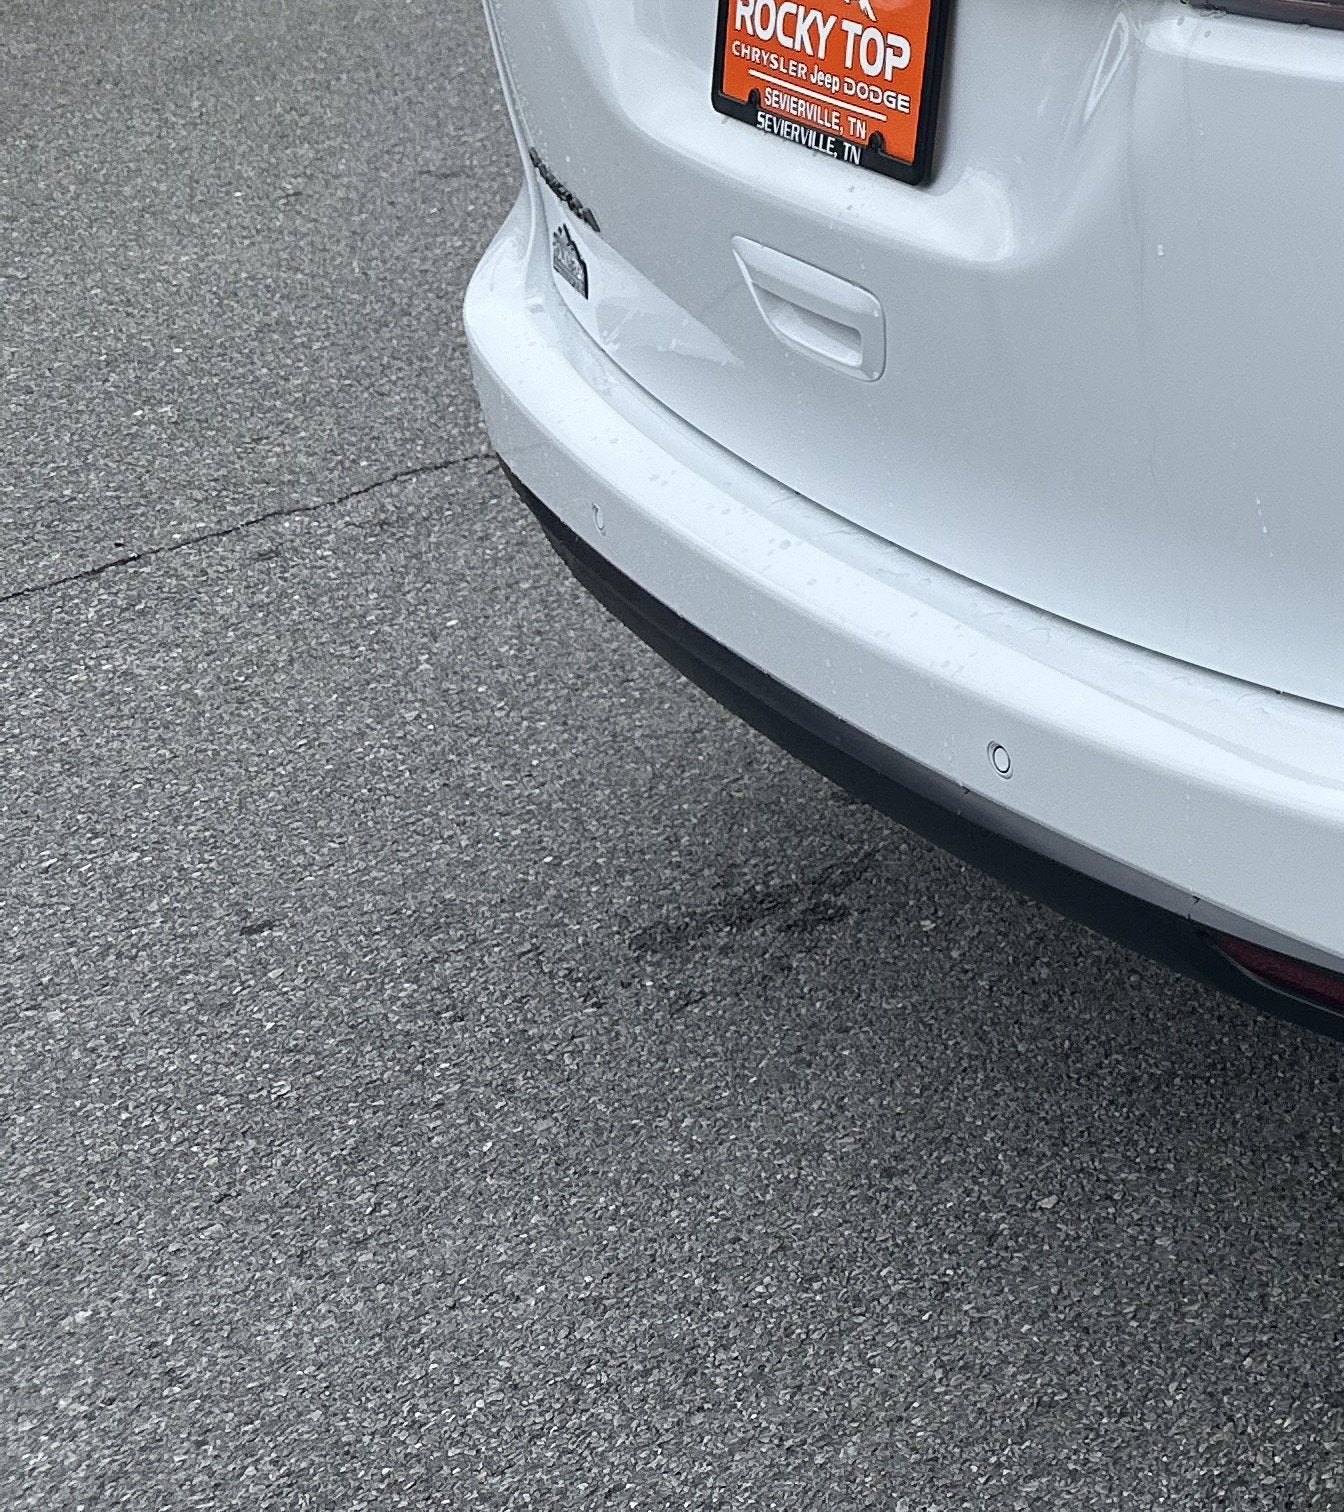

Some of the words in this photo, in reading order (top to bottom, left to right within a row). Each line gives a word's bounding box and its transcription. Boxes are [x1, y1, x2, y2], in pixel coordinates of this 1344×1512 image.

[732, 40, 808, 80] CHRYSLER
[810, 65, 840, 93] Jeep
[843, 76, 911, 114] DODGE
[841, 19, 912, 82] TOP
[756, 111, 838, 159] SEVIERVILLE,
[843, 141, 861, 165] TN
[764, 87, 844, 136] SEVIERVILLE,
[847, 116, 867, 140] TN
